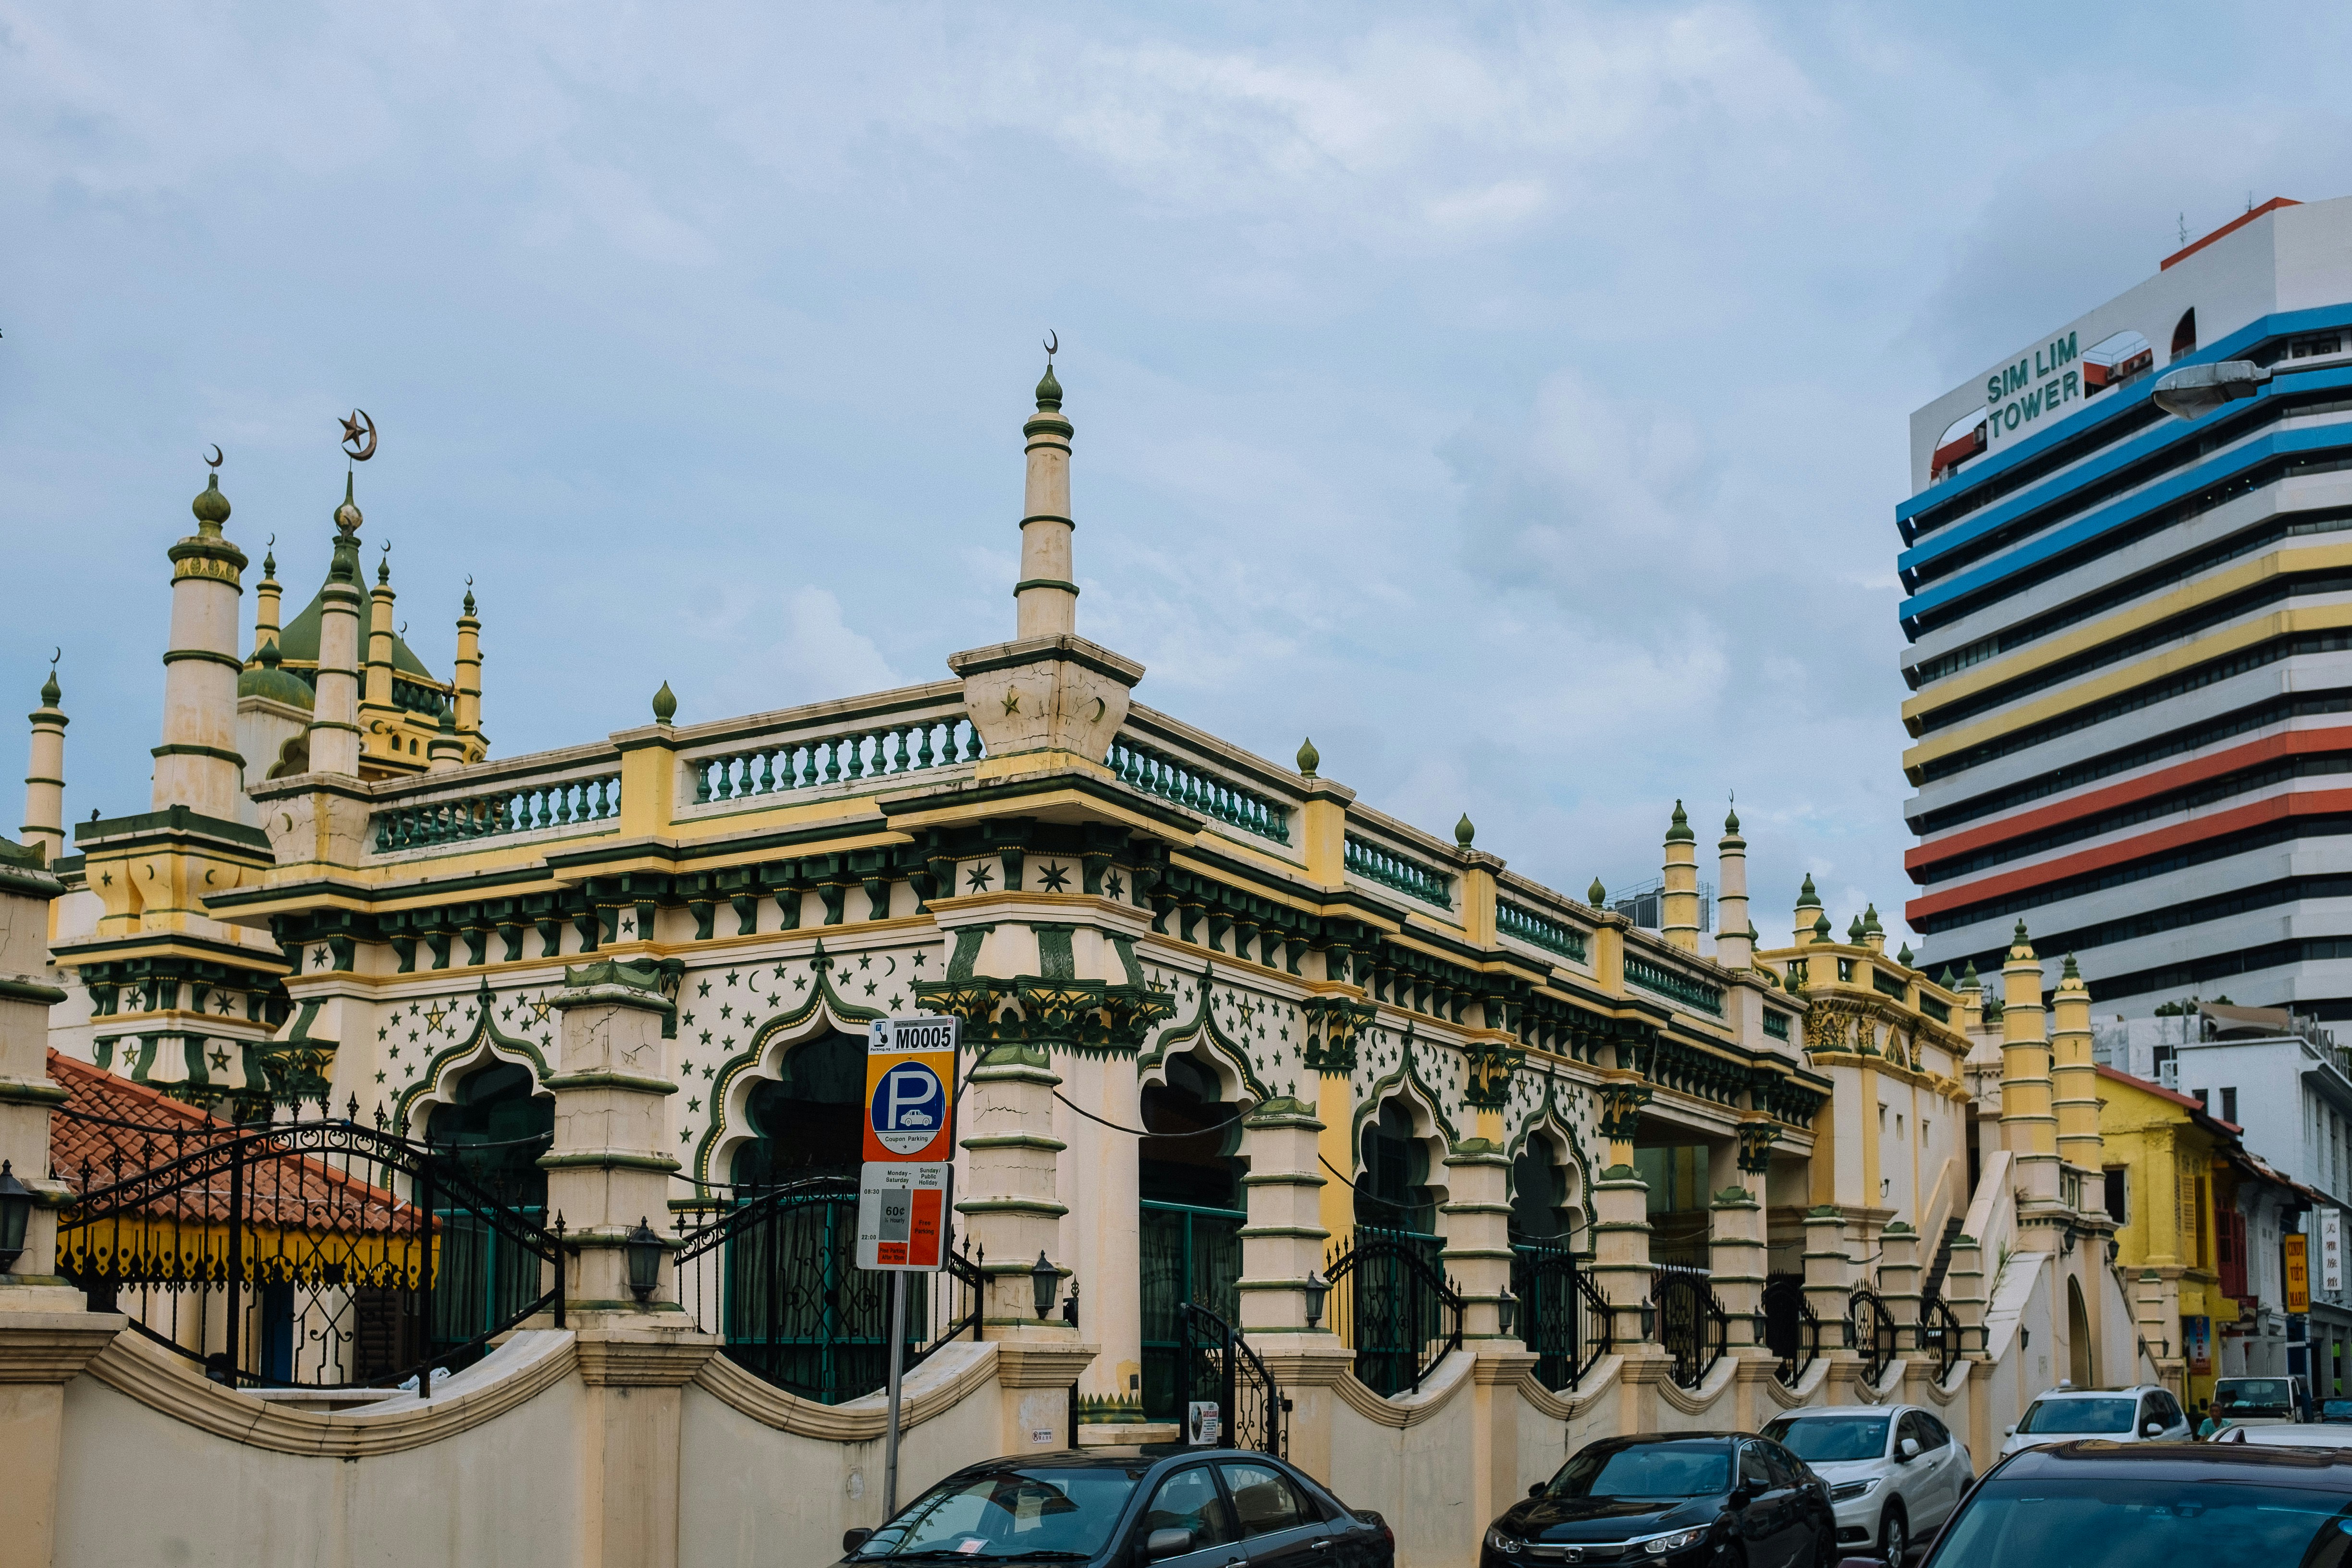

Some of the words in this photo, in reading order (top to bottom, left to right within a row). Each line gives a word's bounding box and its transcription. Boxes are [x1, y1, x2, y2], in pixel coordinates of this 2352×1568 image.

[1988, 358, 2028, 404] SIM
[2036, 331, 2077, 378] LIM
[1989, 371, 2079, 438] TOWER
[896, 1027, 951, 1049] M0005
[888, 1071, 937, 1129] P
[886, 1206, 905, 1216] 60¢
[2288, 1242, 2303, 1256] CINDY
